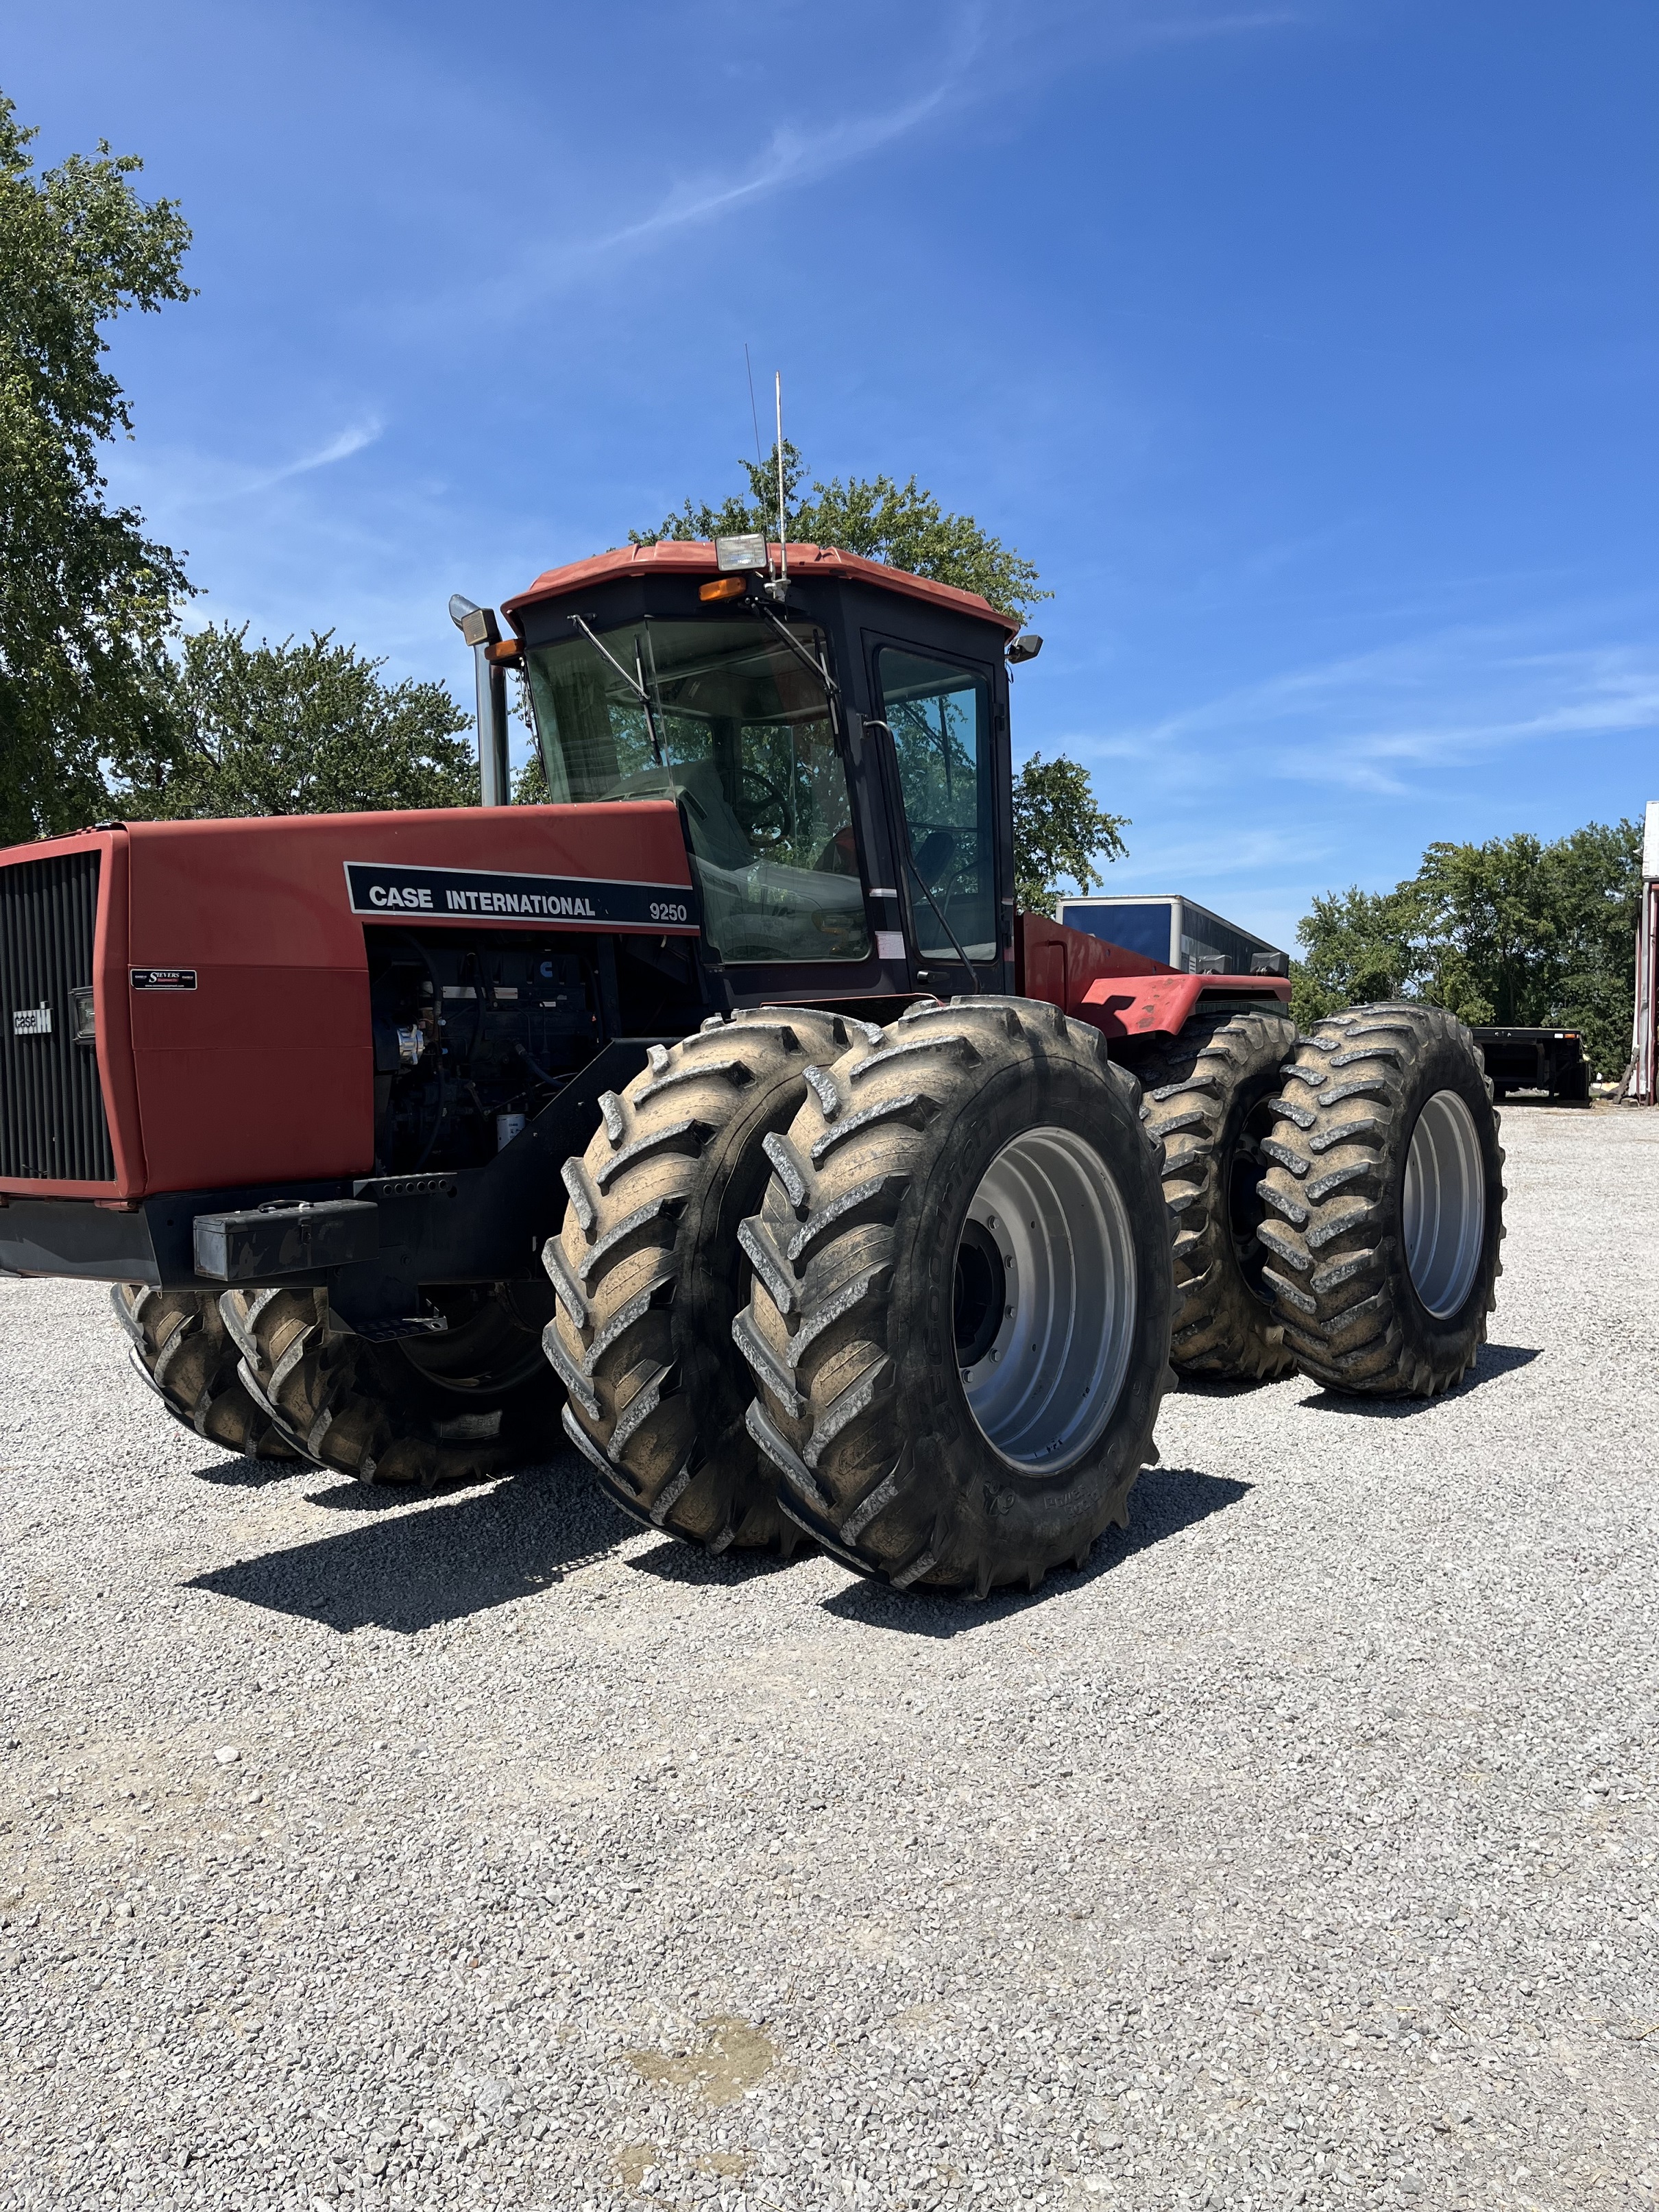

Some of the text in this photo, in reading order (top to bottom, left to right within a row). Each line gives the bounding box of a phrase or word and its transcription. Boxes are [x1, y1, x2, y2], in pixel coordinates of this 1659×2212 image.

[369, 886, 687, 922] CASE INTERNATIONAL 9250
